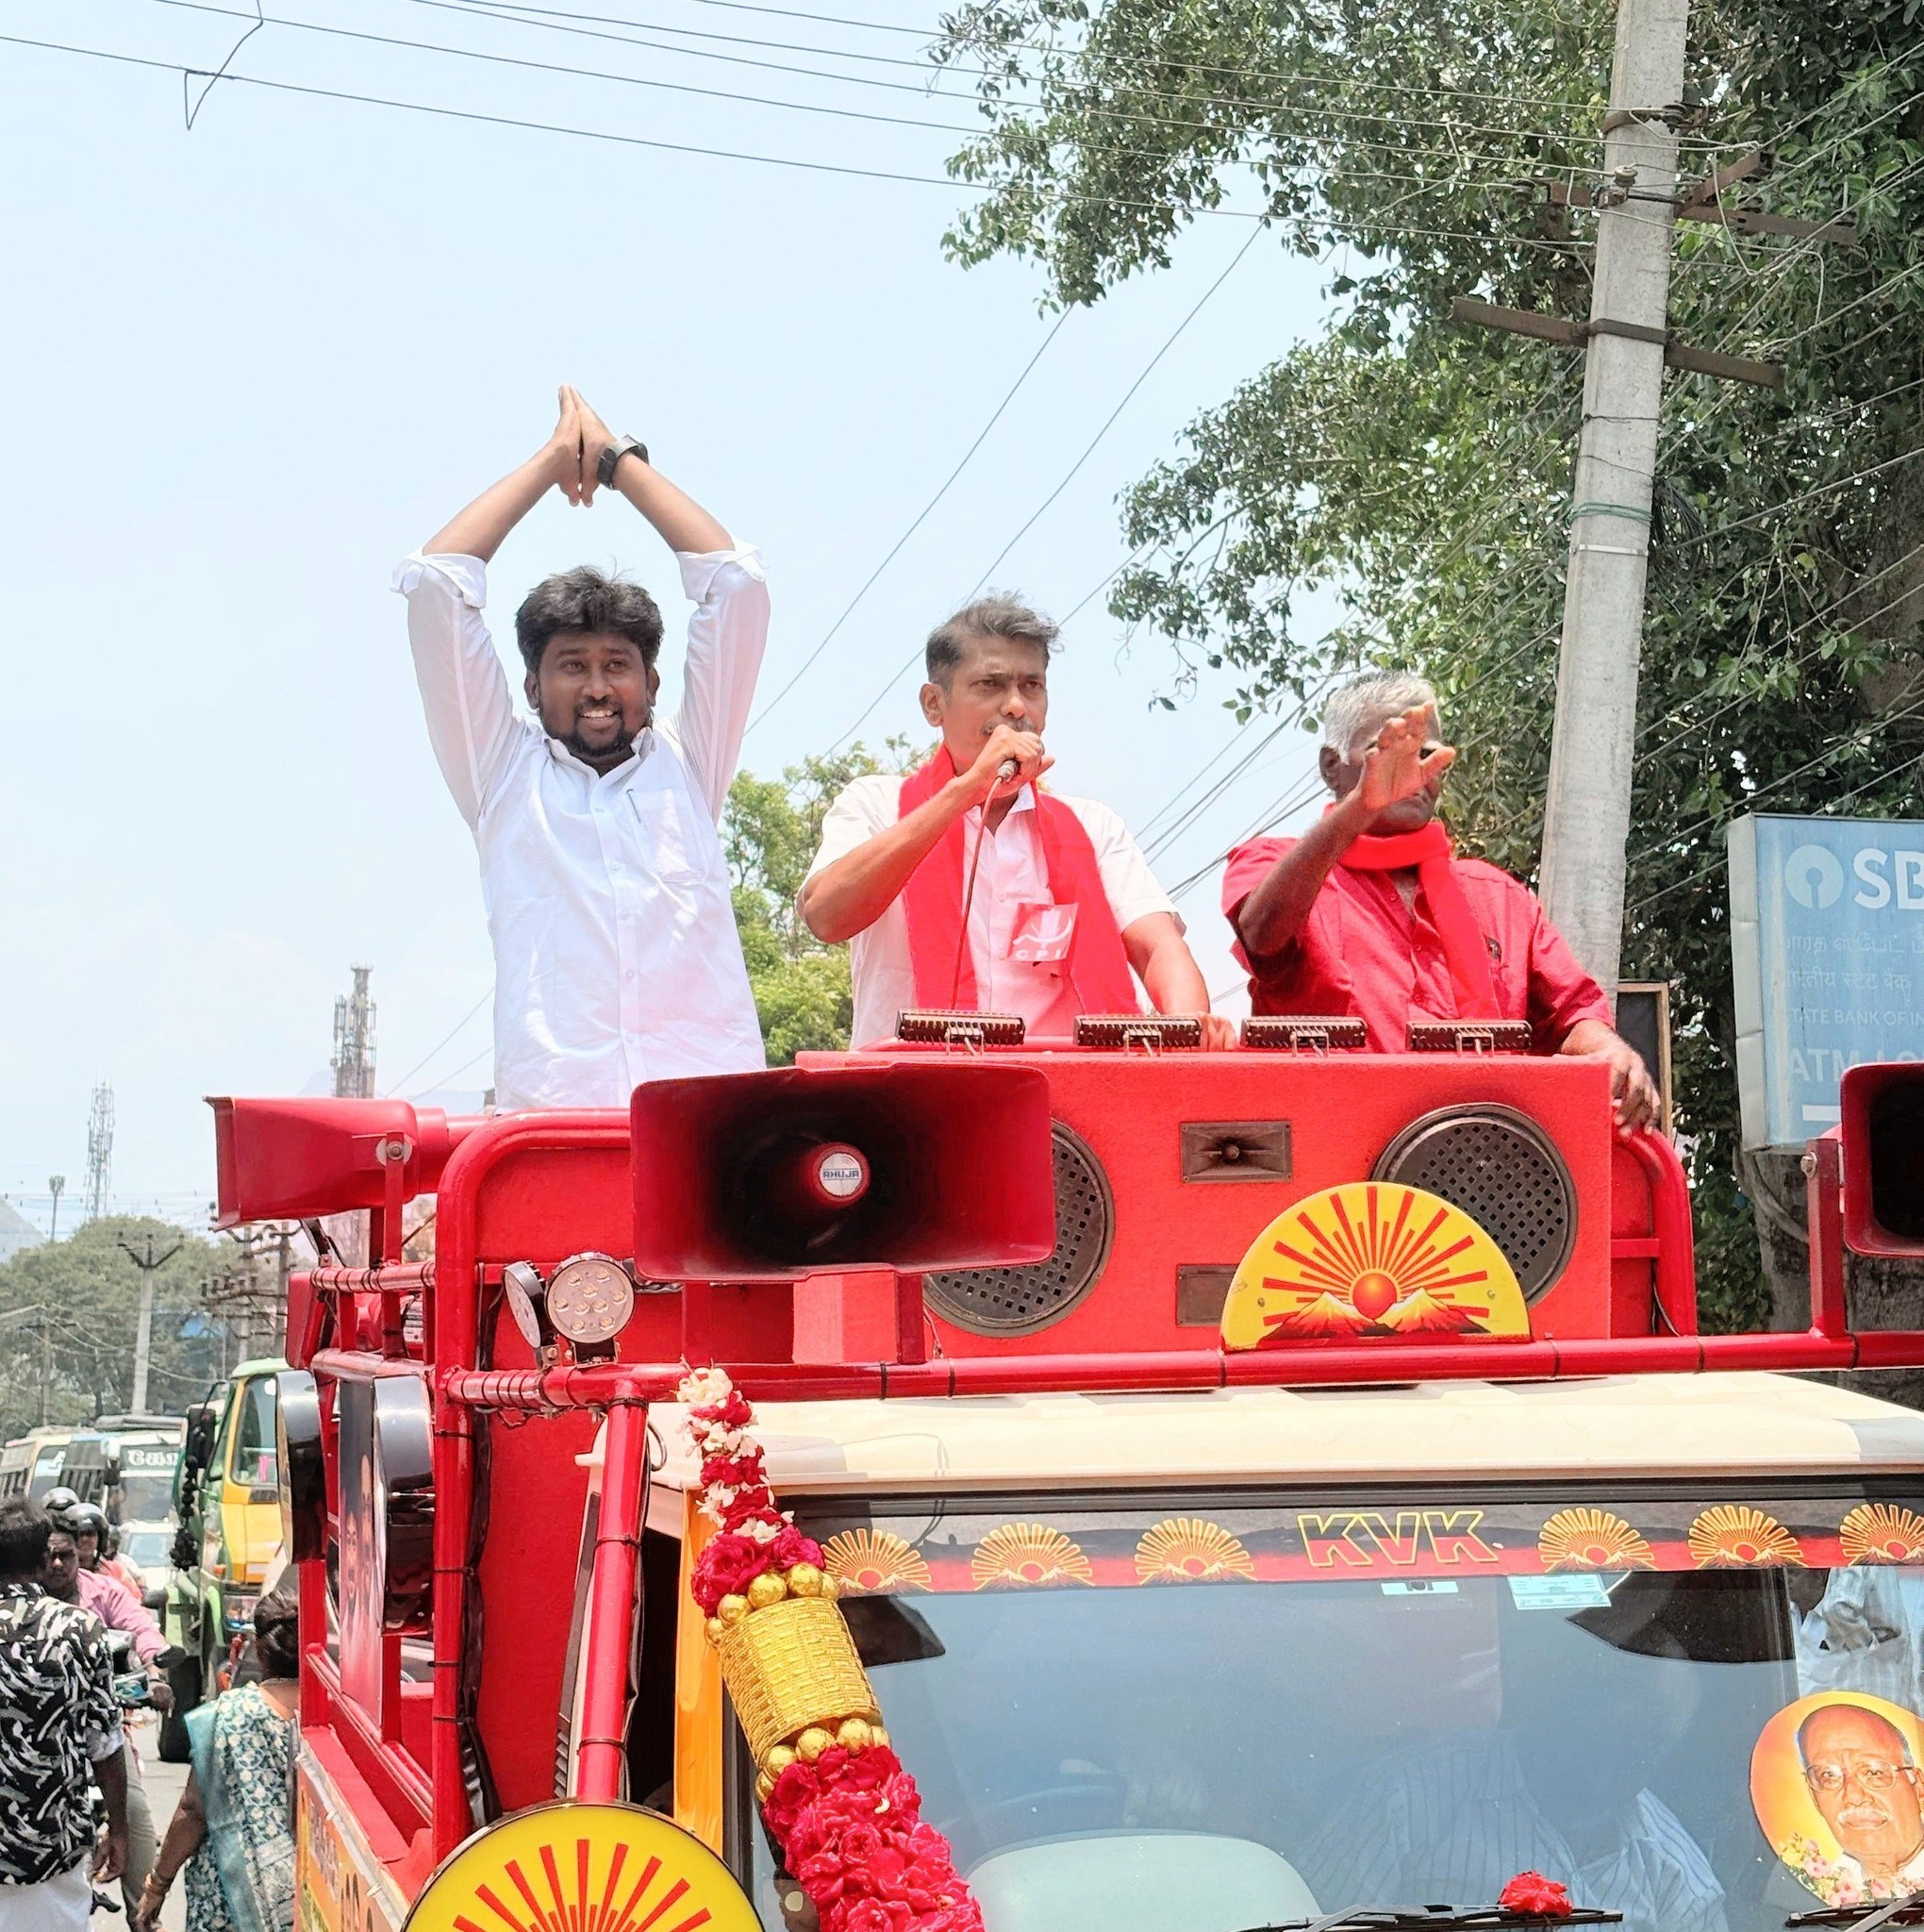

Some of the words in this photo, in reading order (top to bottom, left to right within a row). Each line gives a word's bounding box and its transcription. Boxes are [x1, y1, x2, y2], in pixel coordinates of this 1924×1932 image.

[1015, 949, 1062, 960] CPI
[1788, 1008, 1831, 1024] TATE
[1834, 1009, 1880, 1025] BANK
[1883, 1010, 1906, 1026] OF
[822, 1170, 860, 1178] AHUJA
[1297, 1510, 1500, 1567] KVK
